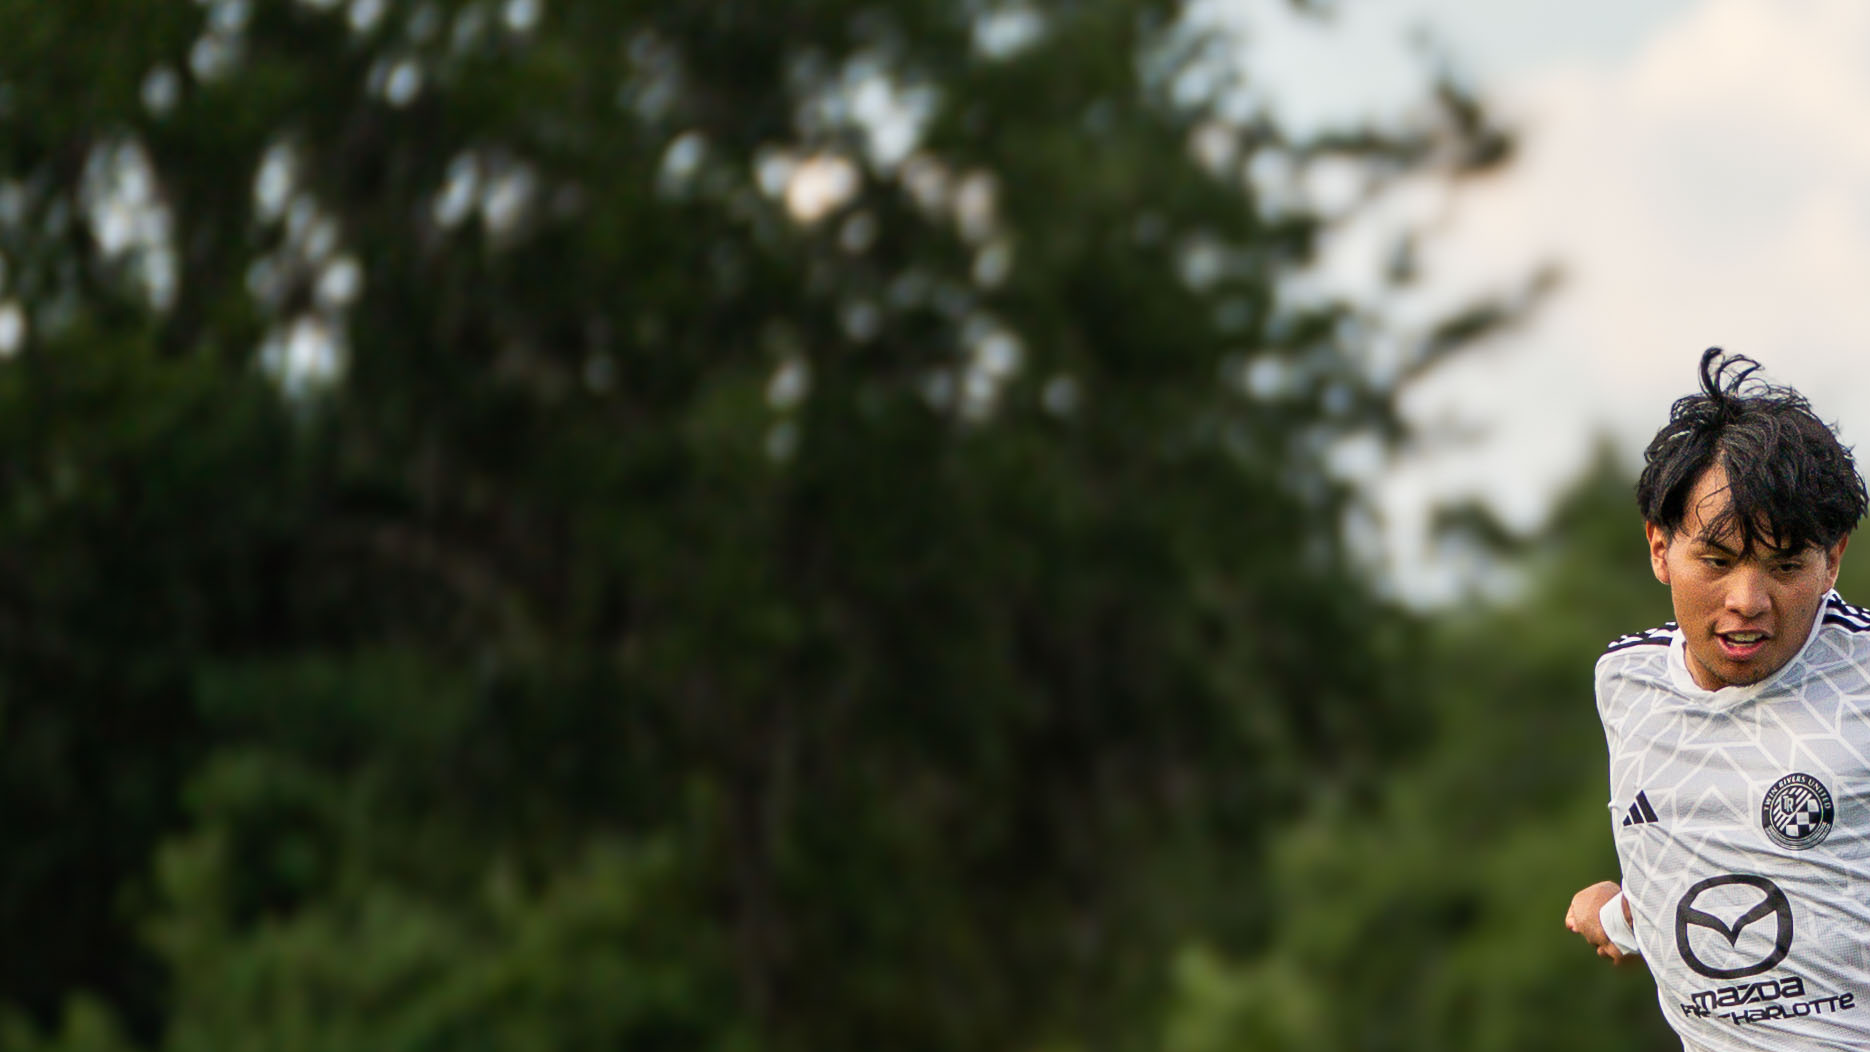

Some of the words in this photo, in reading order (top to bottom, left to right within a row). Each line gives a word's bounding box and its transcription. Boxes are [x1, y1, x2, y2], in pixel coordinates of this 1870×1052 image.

[1778, 775, 1806, 788] RIVERS
[1807, 778, 1832, 810] UNITED
[1718, 993, 1855, 1025] HaRLOTTe
